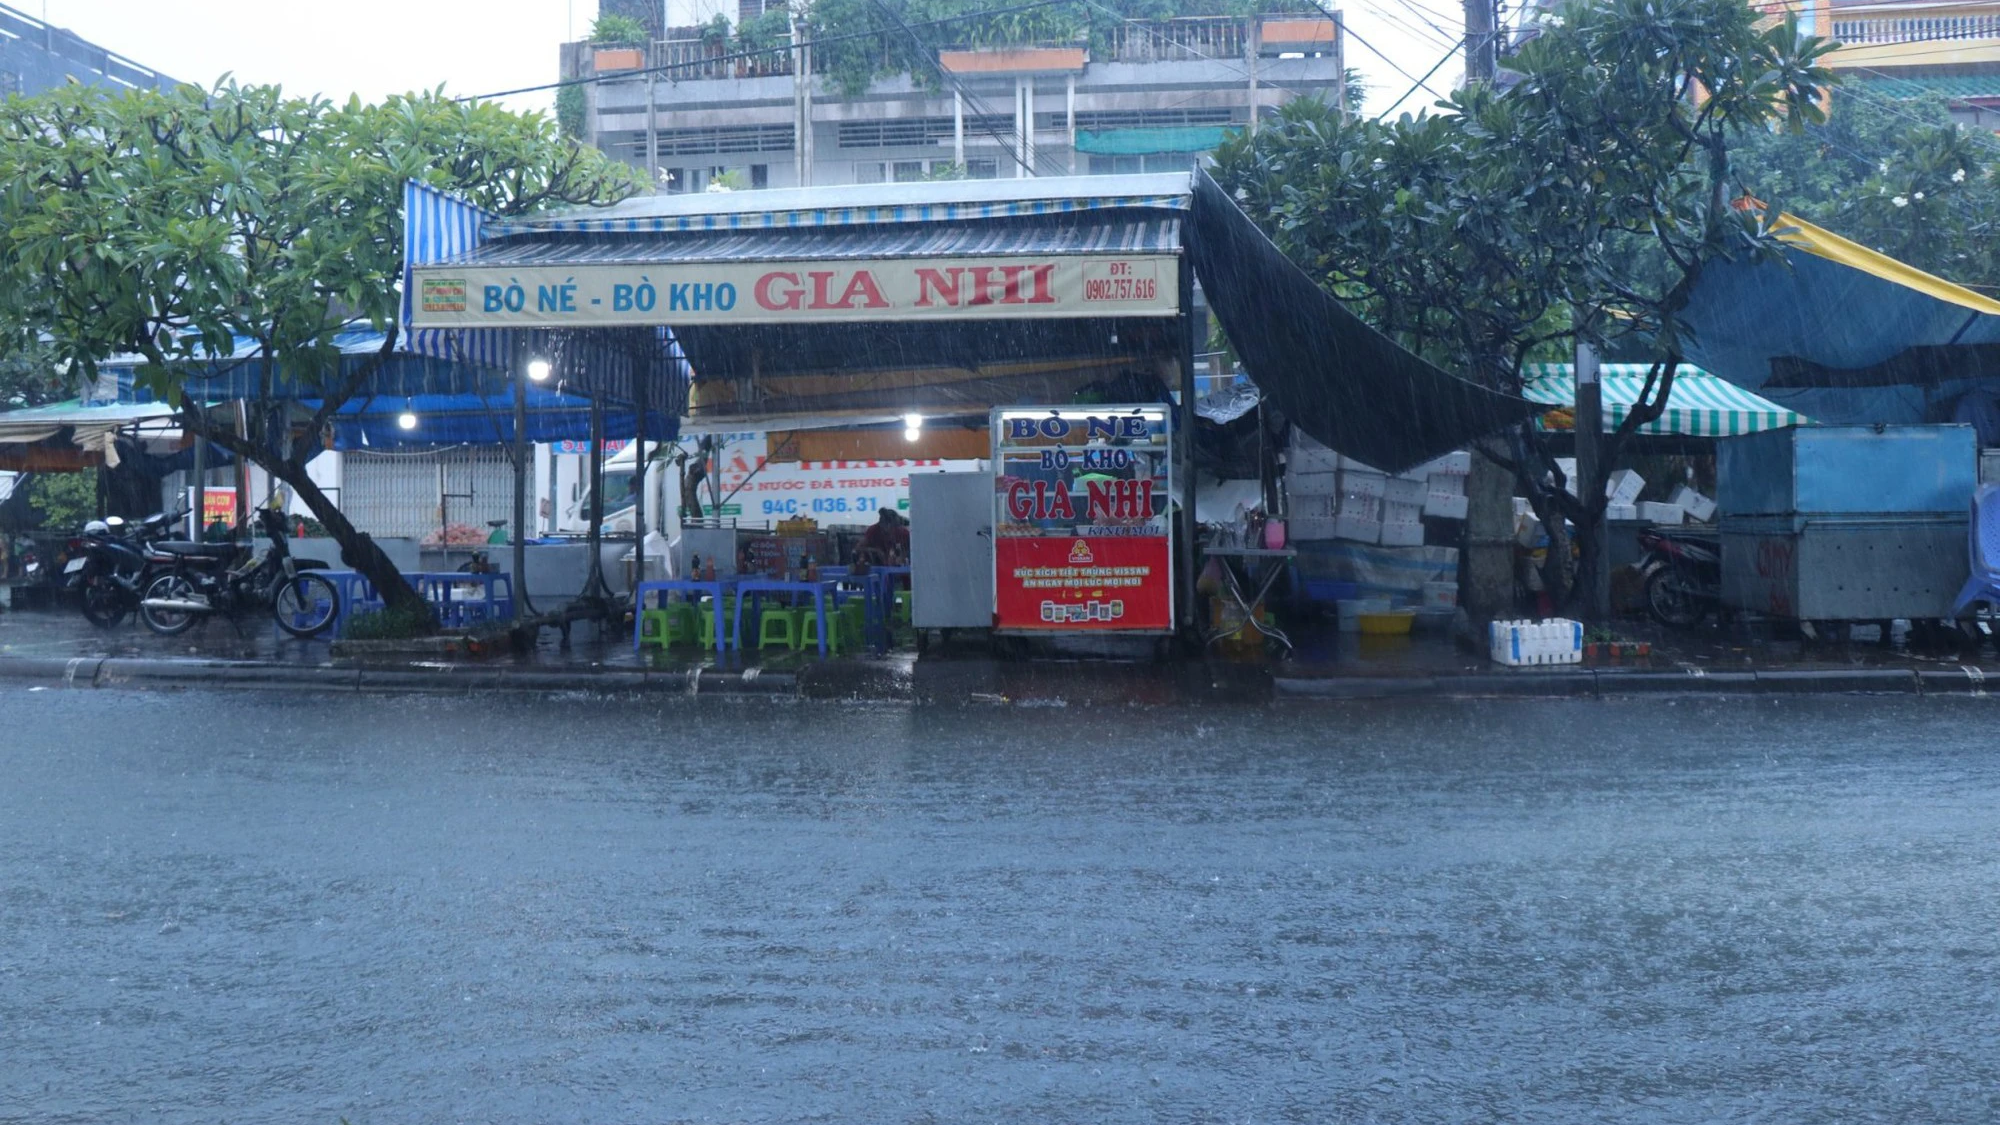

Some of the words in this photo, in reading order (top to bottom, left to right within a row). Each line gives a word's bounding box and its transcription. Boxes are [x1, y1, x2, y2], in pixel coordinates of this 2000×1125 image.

[1110, 262, 1132, 276] ĐT:
[483, 277, 525, 313] BÒ
[537, 276, 577, 313] NÉ
[613, 275, 656, 312] BÒ
[669, 282, 737, 312] KHO
[754, 270, 890, 311] GIA
[914, 264, 1055, 307] NHI
[1086, 279, 1155, 300] 0902.757.616
[1009, 409, 1071, 439] BÒ
[1086, 408, 1149, 439] NÉ
[1040, 444, 1069, 470] BÒ
[1082, 448, 1130, 470] KHO
[838, 478, 895, 489] TRUNG
[762, 499, 797, 515] 94C
[1008, 479, 1075, 520] GIA
[1086, 479, 1154, 519] NHI
[1014, 565, 1033, 577] XÚC
[1035, 565, 1057, 577] XÍCH
[1113, 566, 1149, 577] VISSAN
[1038, 577, 1062, 588] NGAY
